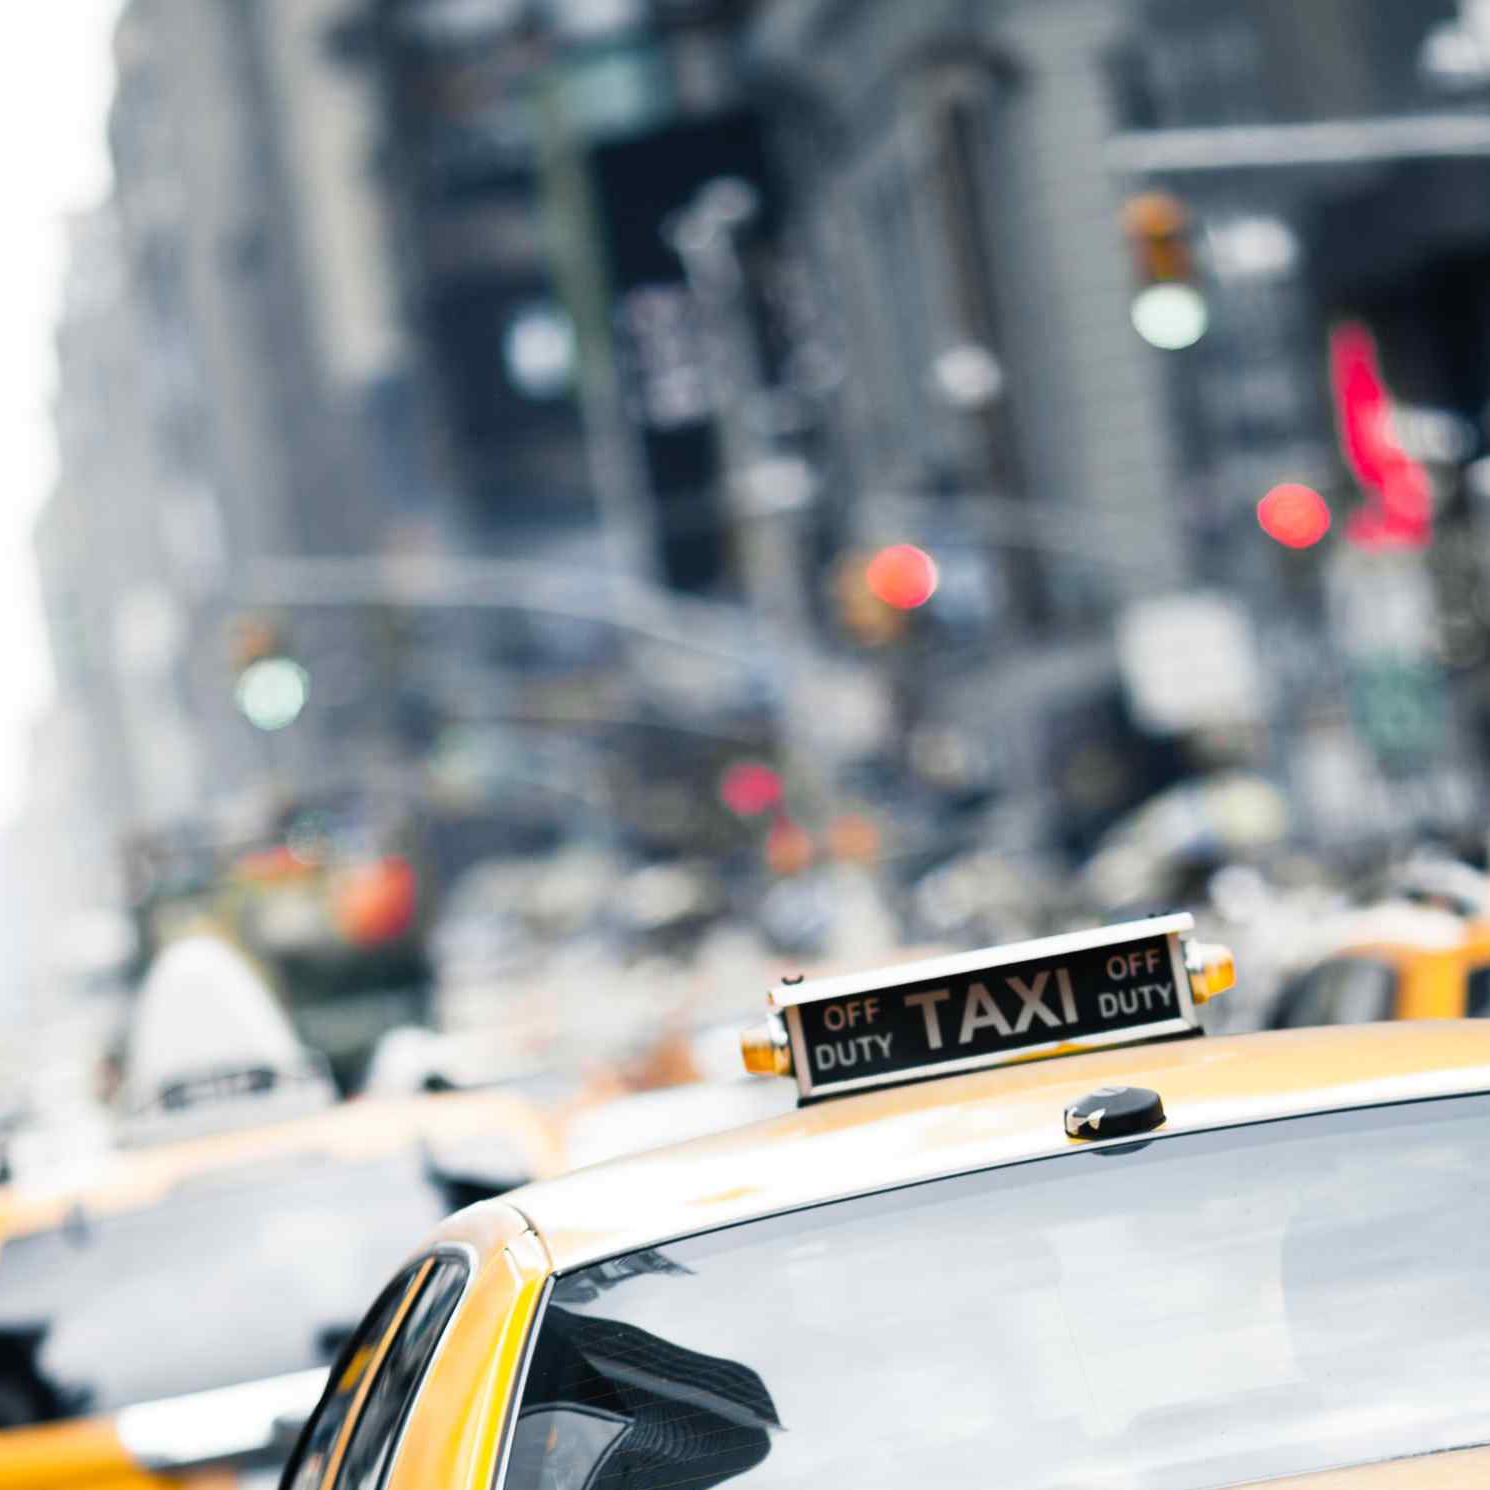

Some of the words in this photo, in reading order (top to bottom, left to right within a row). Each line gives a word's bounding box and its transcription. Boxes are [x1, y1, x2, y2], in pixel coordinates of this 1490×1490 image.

[1105, 949, 1162, 981] OFF
[823, 997, 880, 1031] OFF
[905, 968, 1079, 1050] TAXI
[1097, 981, 1174, 1019] DUTY
[814, 1031, 894, 1072] DUTY
